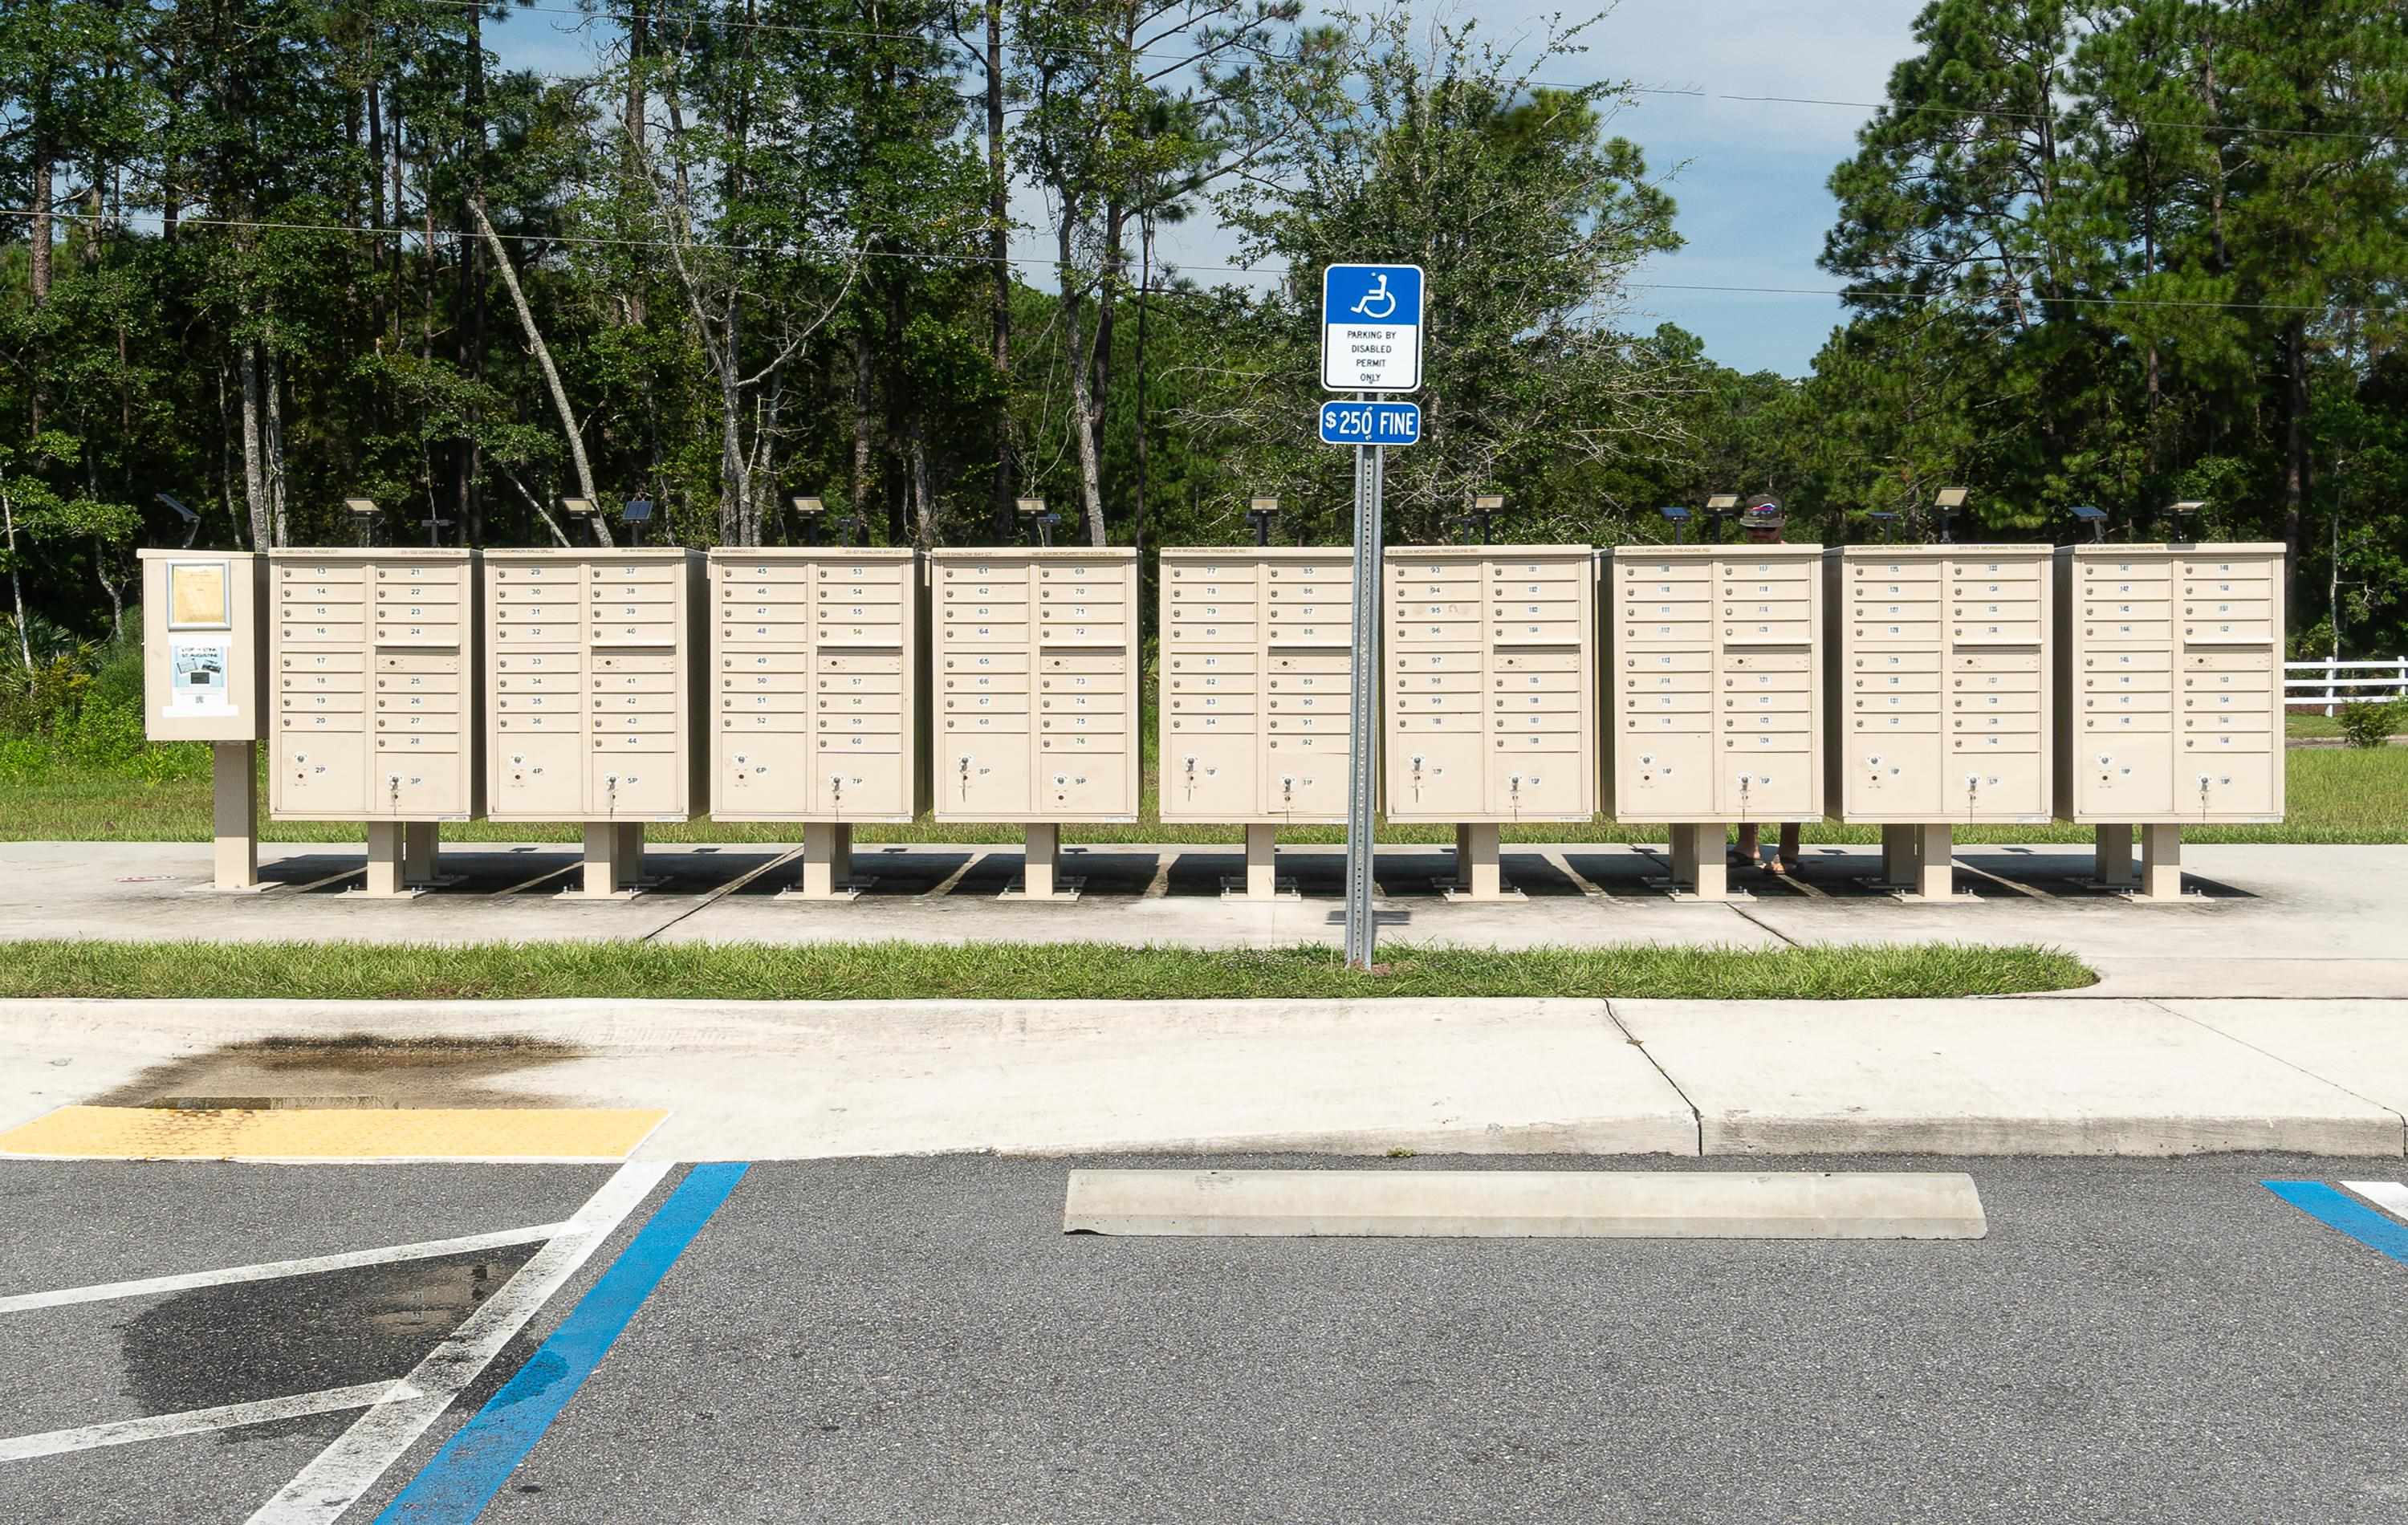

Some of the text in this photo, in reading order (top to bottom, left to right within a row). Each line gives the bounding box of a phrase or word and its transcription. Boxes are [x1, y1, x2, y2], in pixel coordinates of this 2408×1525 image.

[1347, 331, 1397, 340] PARKING BY
[1352, 344, 1392, 353] DISABLED
[1357, 359, 1386, 367] PERMIT
[1361, 373, 1381, 381] ONLY
[1325, 410, 1416, 435] $250 FINE
